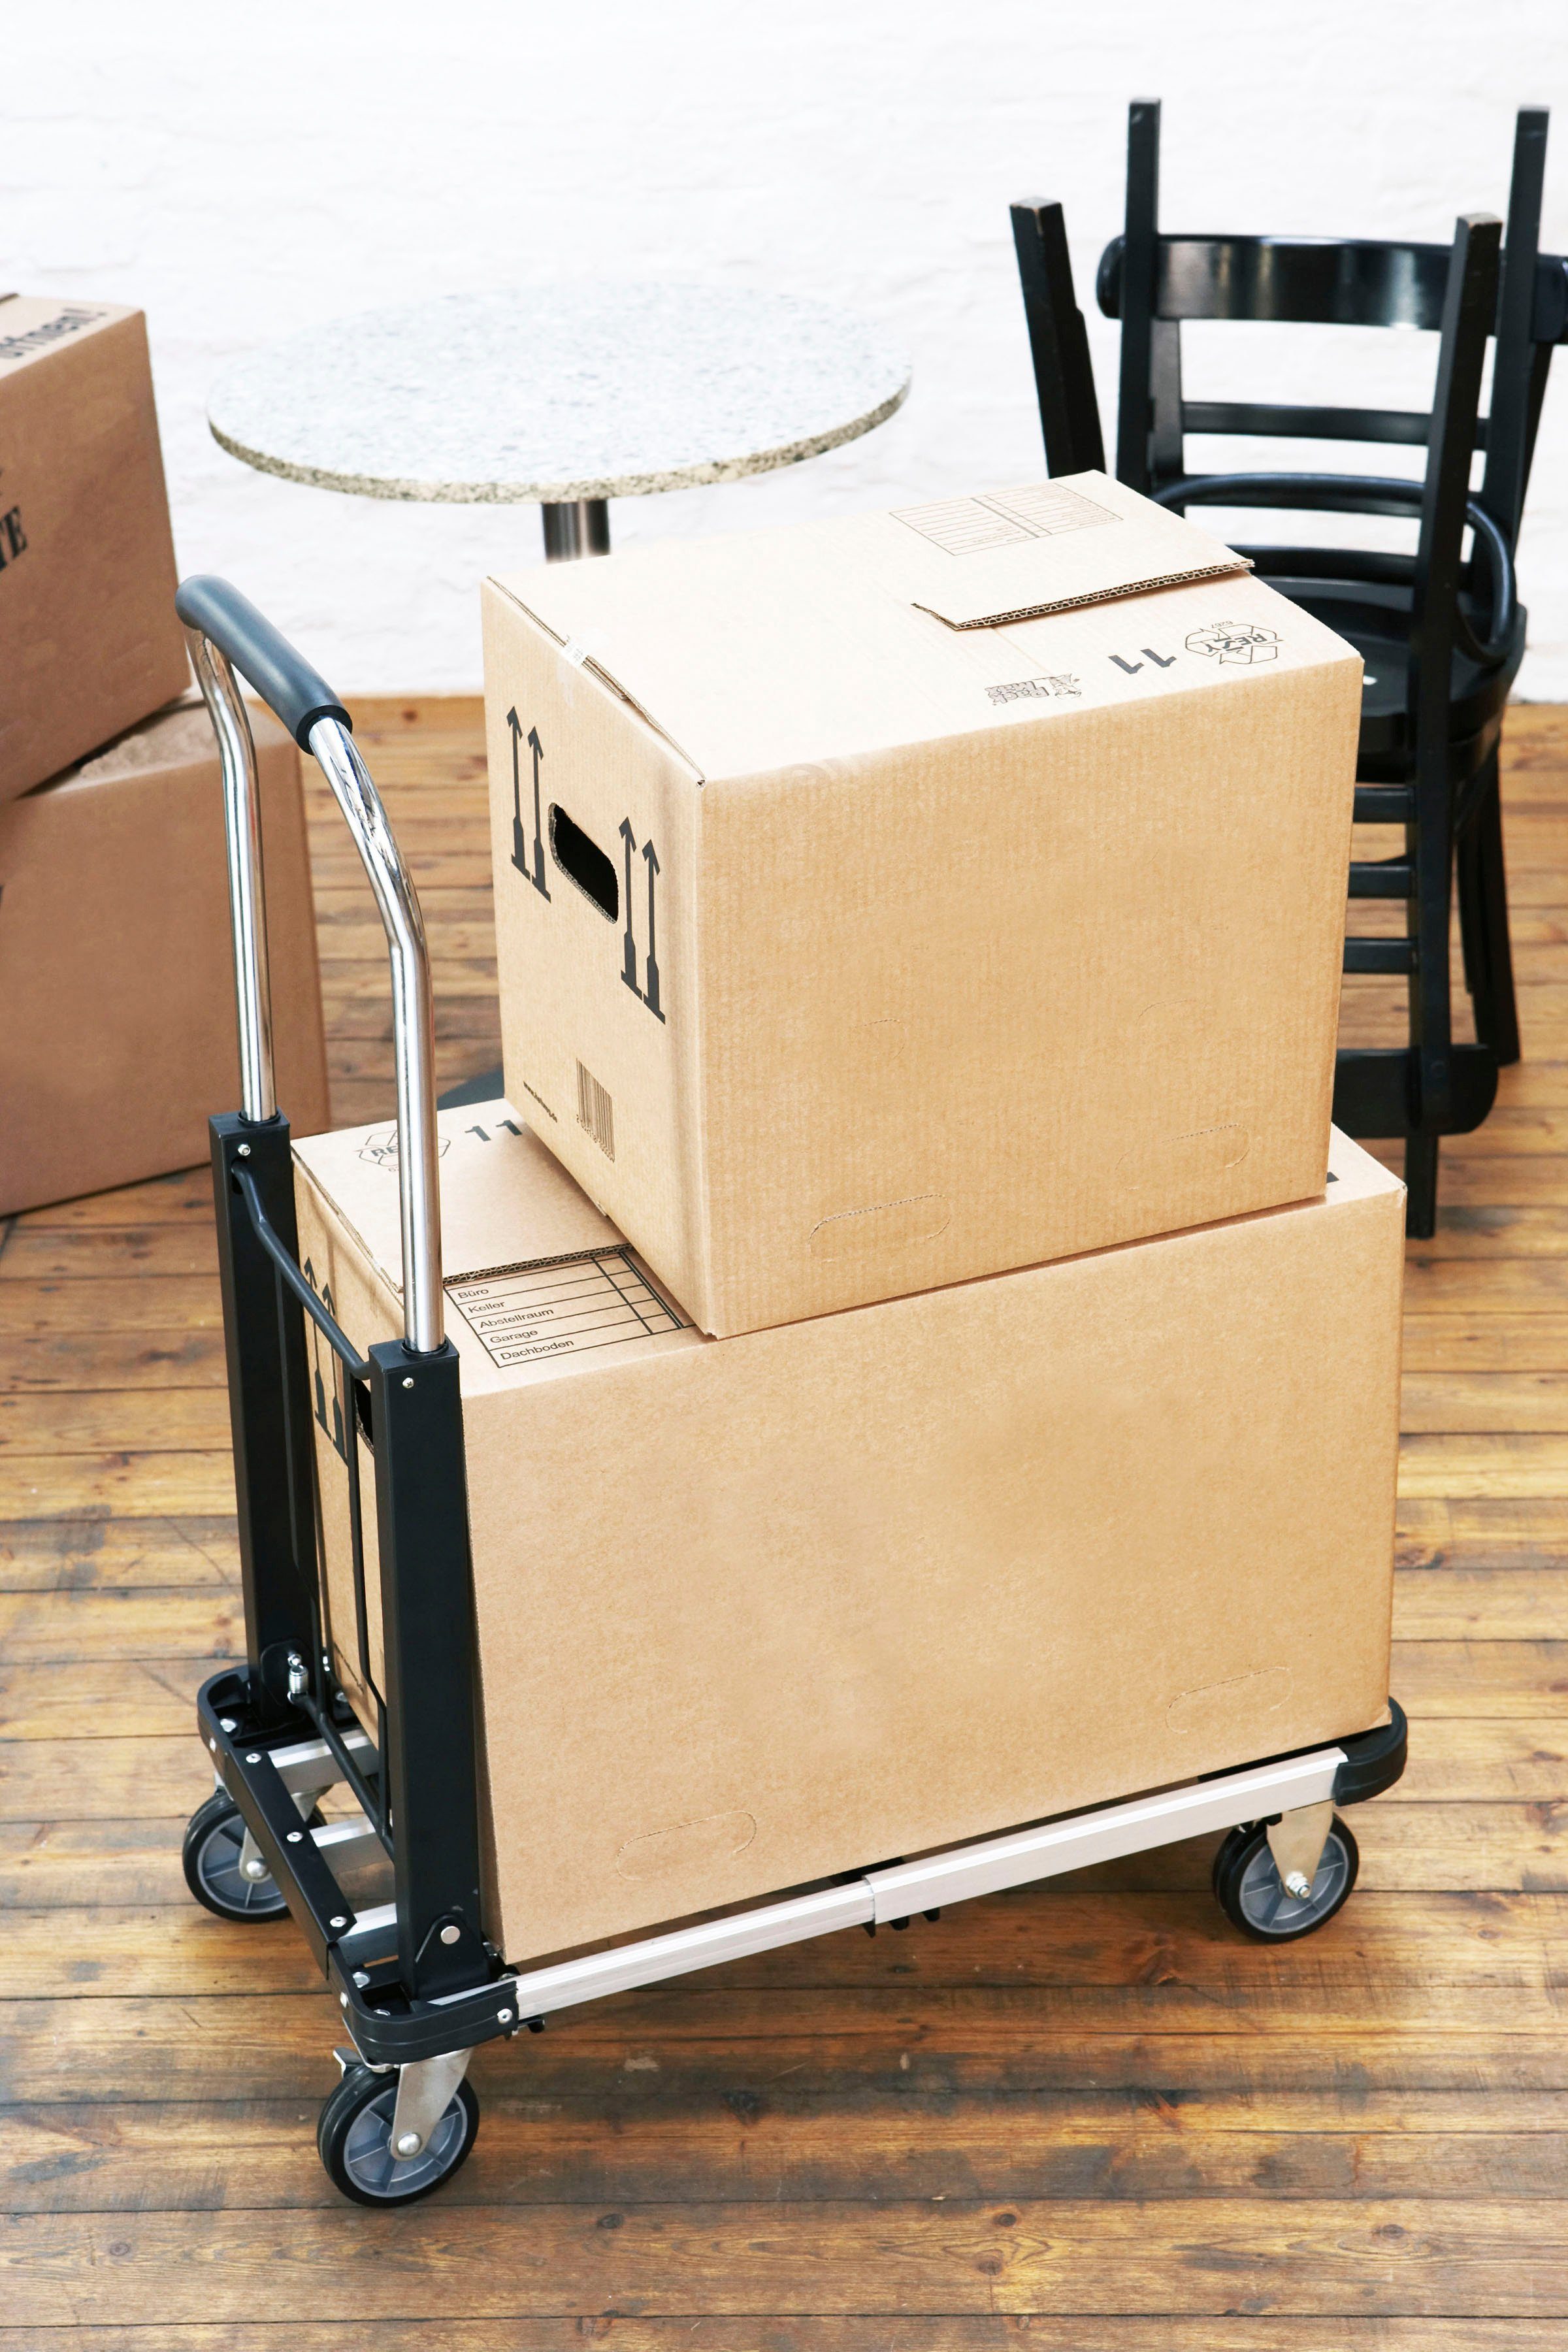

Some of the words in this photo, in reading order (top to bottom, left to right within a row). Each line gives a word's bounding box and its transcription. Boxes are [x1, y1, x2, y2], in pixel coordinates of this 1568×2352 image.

[1108, 648, 1177, 674] 11
[985, 681, 1037, 696] Max
[989, 687, 1049, 704] Pack
[465, 1119, 522, 1141] 11
[458, 1289, 489, 1299] Büro
[468, 1302, 505, 1313] Keller
[480, 1309, 554, 1328] Abstellraum
[490, 1330, 538, 1343] Garage
[500, 1341, 574, 1360] Dachboden
